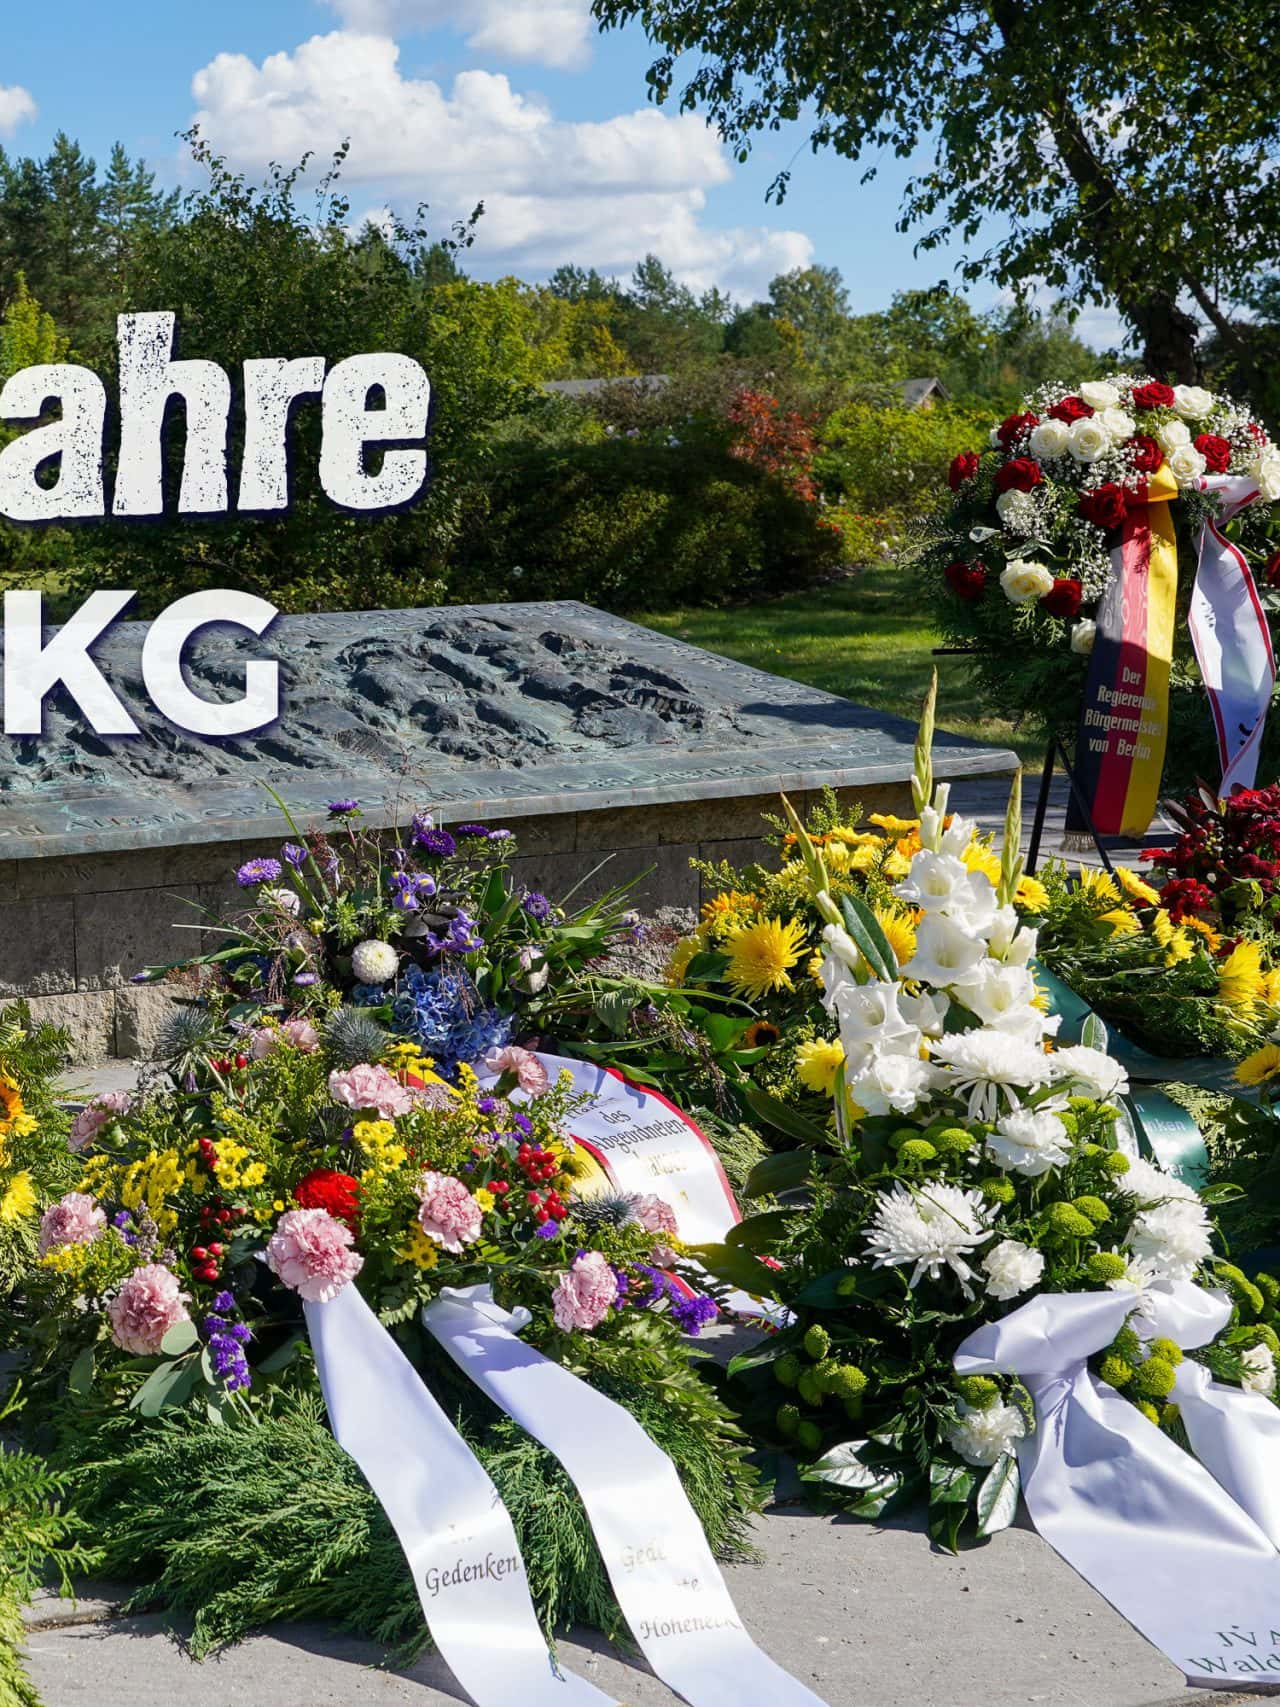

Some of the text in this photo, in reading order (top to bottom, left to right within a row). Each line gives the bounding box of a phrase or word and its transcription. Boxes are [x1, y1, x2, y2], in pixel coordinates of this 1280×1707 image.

[1121, 666, 1141, 685] Der
[1089, 738, 1151, 760] von Berlin
[599, 1110, 631, 1124] des
[425, 1551, 520, 1597] Gedenken
